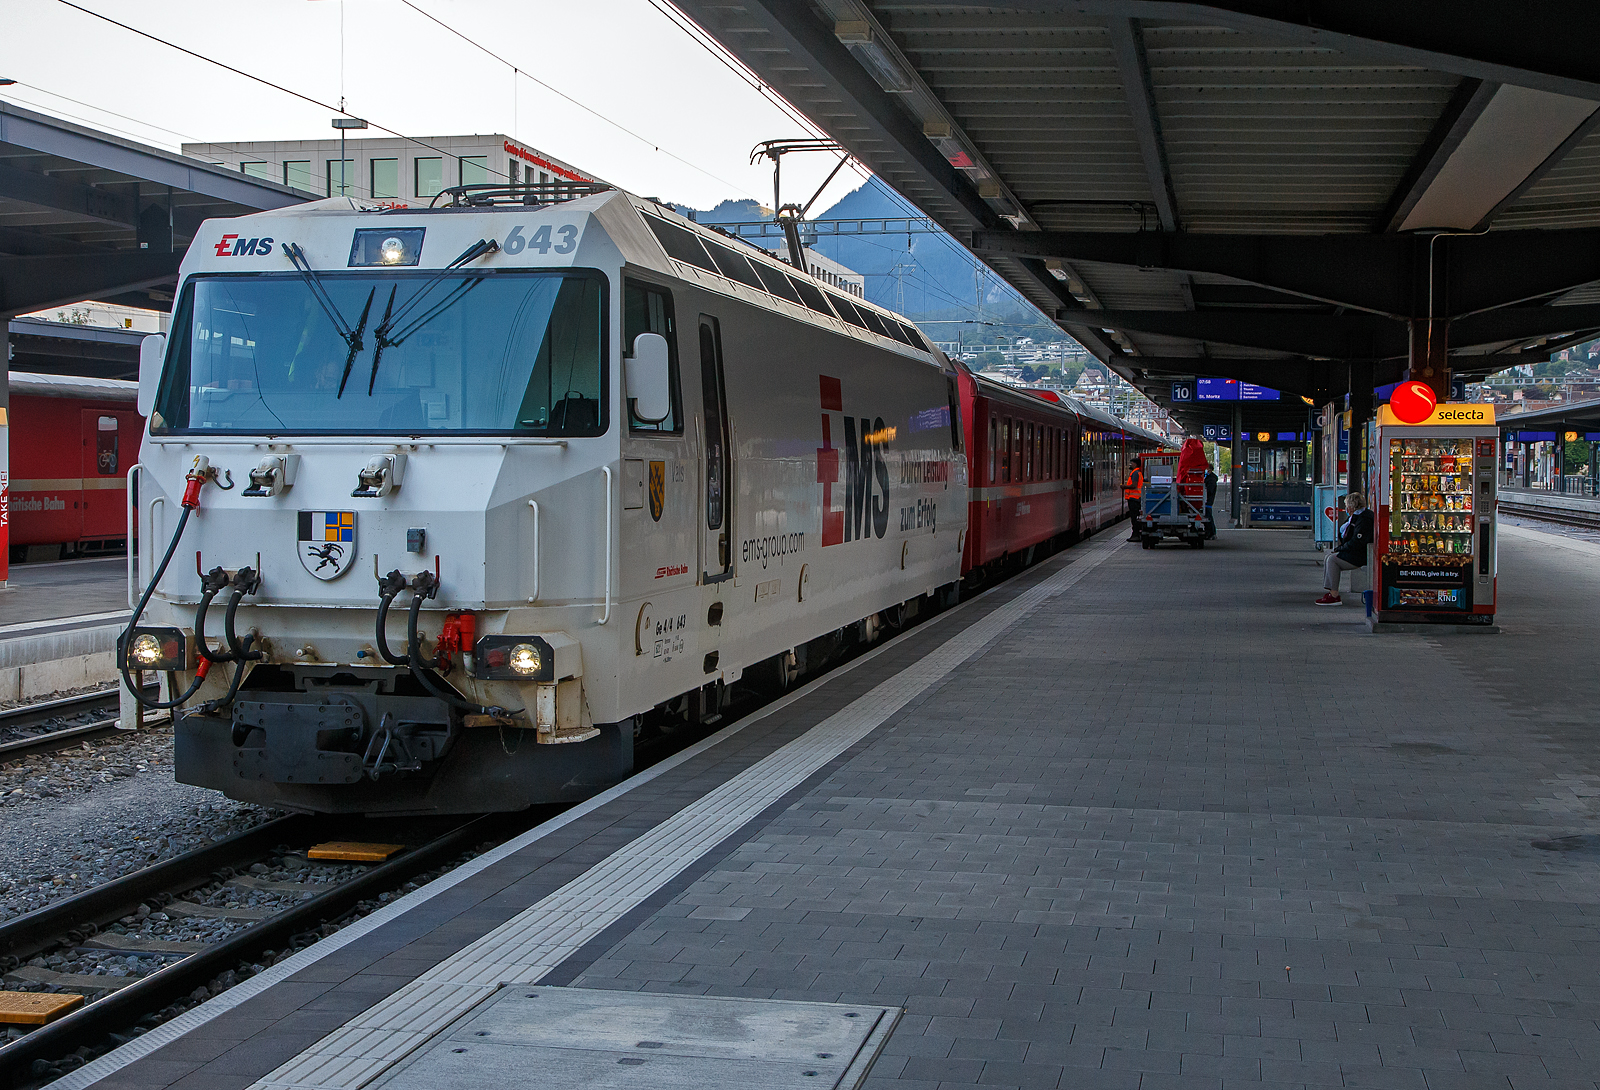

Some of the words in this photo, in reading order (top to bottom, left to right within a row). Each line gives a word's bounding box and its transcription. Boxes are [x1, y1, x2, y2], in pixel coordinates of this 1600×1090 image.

[214, 233, 275, 257] EMS
[503, 224, 579, 256] 643
[1175, 387, 1190, 399] 10
[1438, 409, 1484, 420] selecta
[1205, 428, 1215, 436] 10
[1220, 428, 1228, 436] C
[816, 374, 890, 548] EMS
[0, 471, 8, 495] ME!
[0, 495, 8, 528] TAKE
[9, 496, 42, 511] hätische
[44, 495, 65, 511] Bahn
[917, 498, 937, 534] Erfolg
[742, 531, 805, 570] ems-group.com
